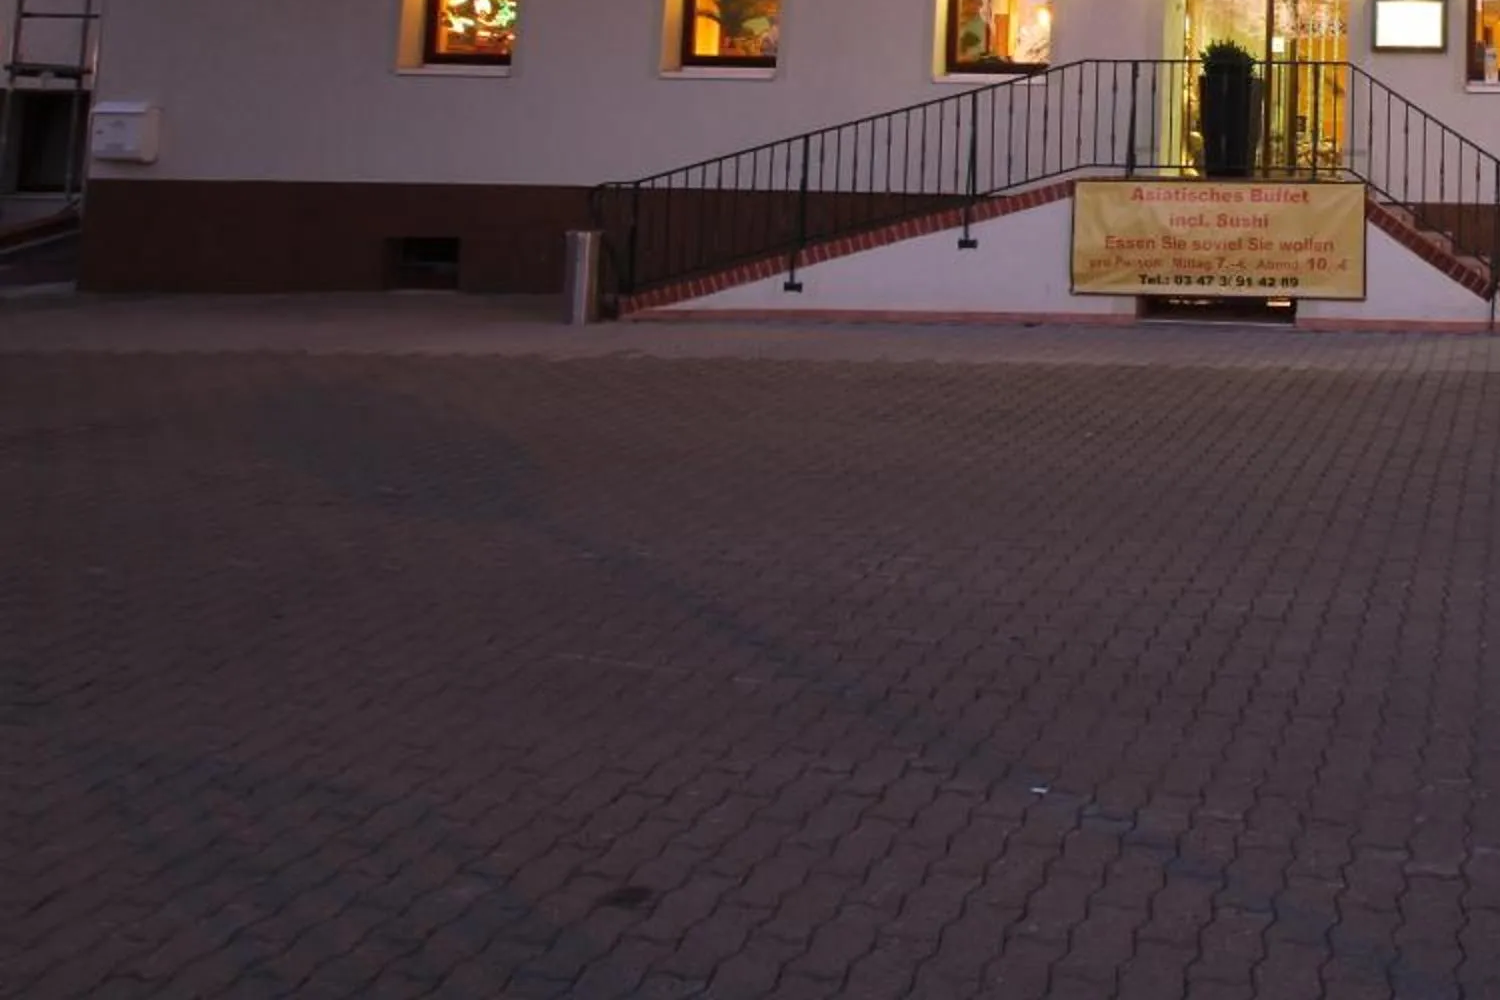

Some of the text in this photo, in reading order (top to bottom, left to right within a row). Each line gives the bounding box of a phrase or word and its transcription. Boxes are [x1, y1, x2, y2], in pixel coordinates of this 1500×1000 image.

[1130, 186, 1310, 204] Asiatisches Buffet
[1169, 212, 1269, 229] incl. Sushi
[1104, 235, 1335, 253] Essen Sie soviel Sie wollen
